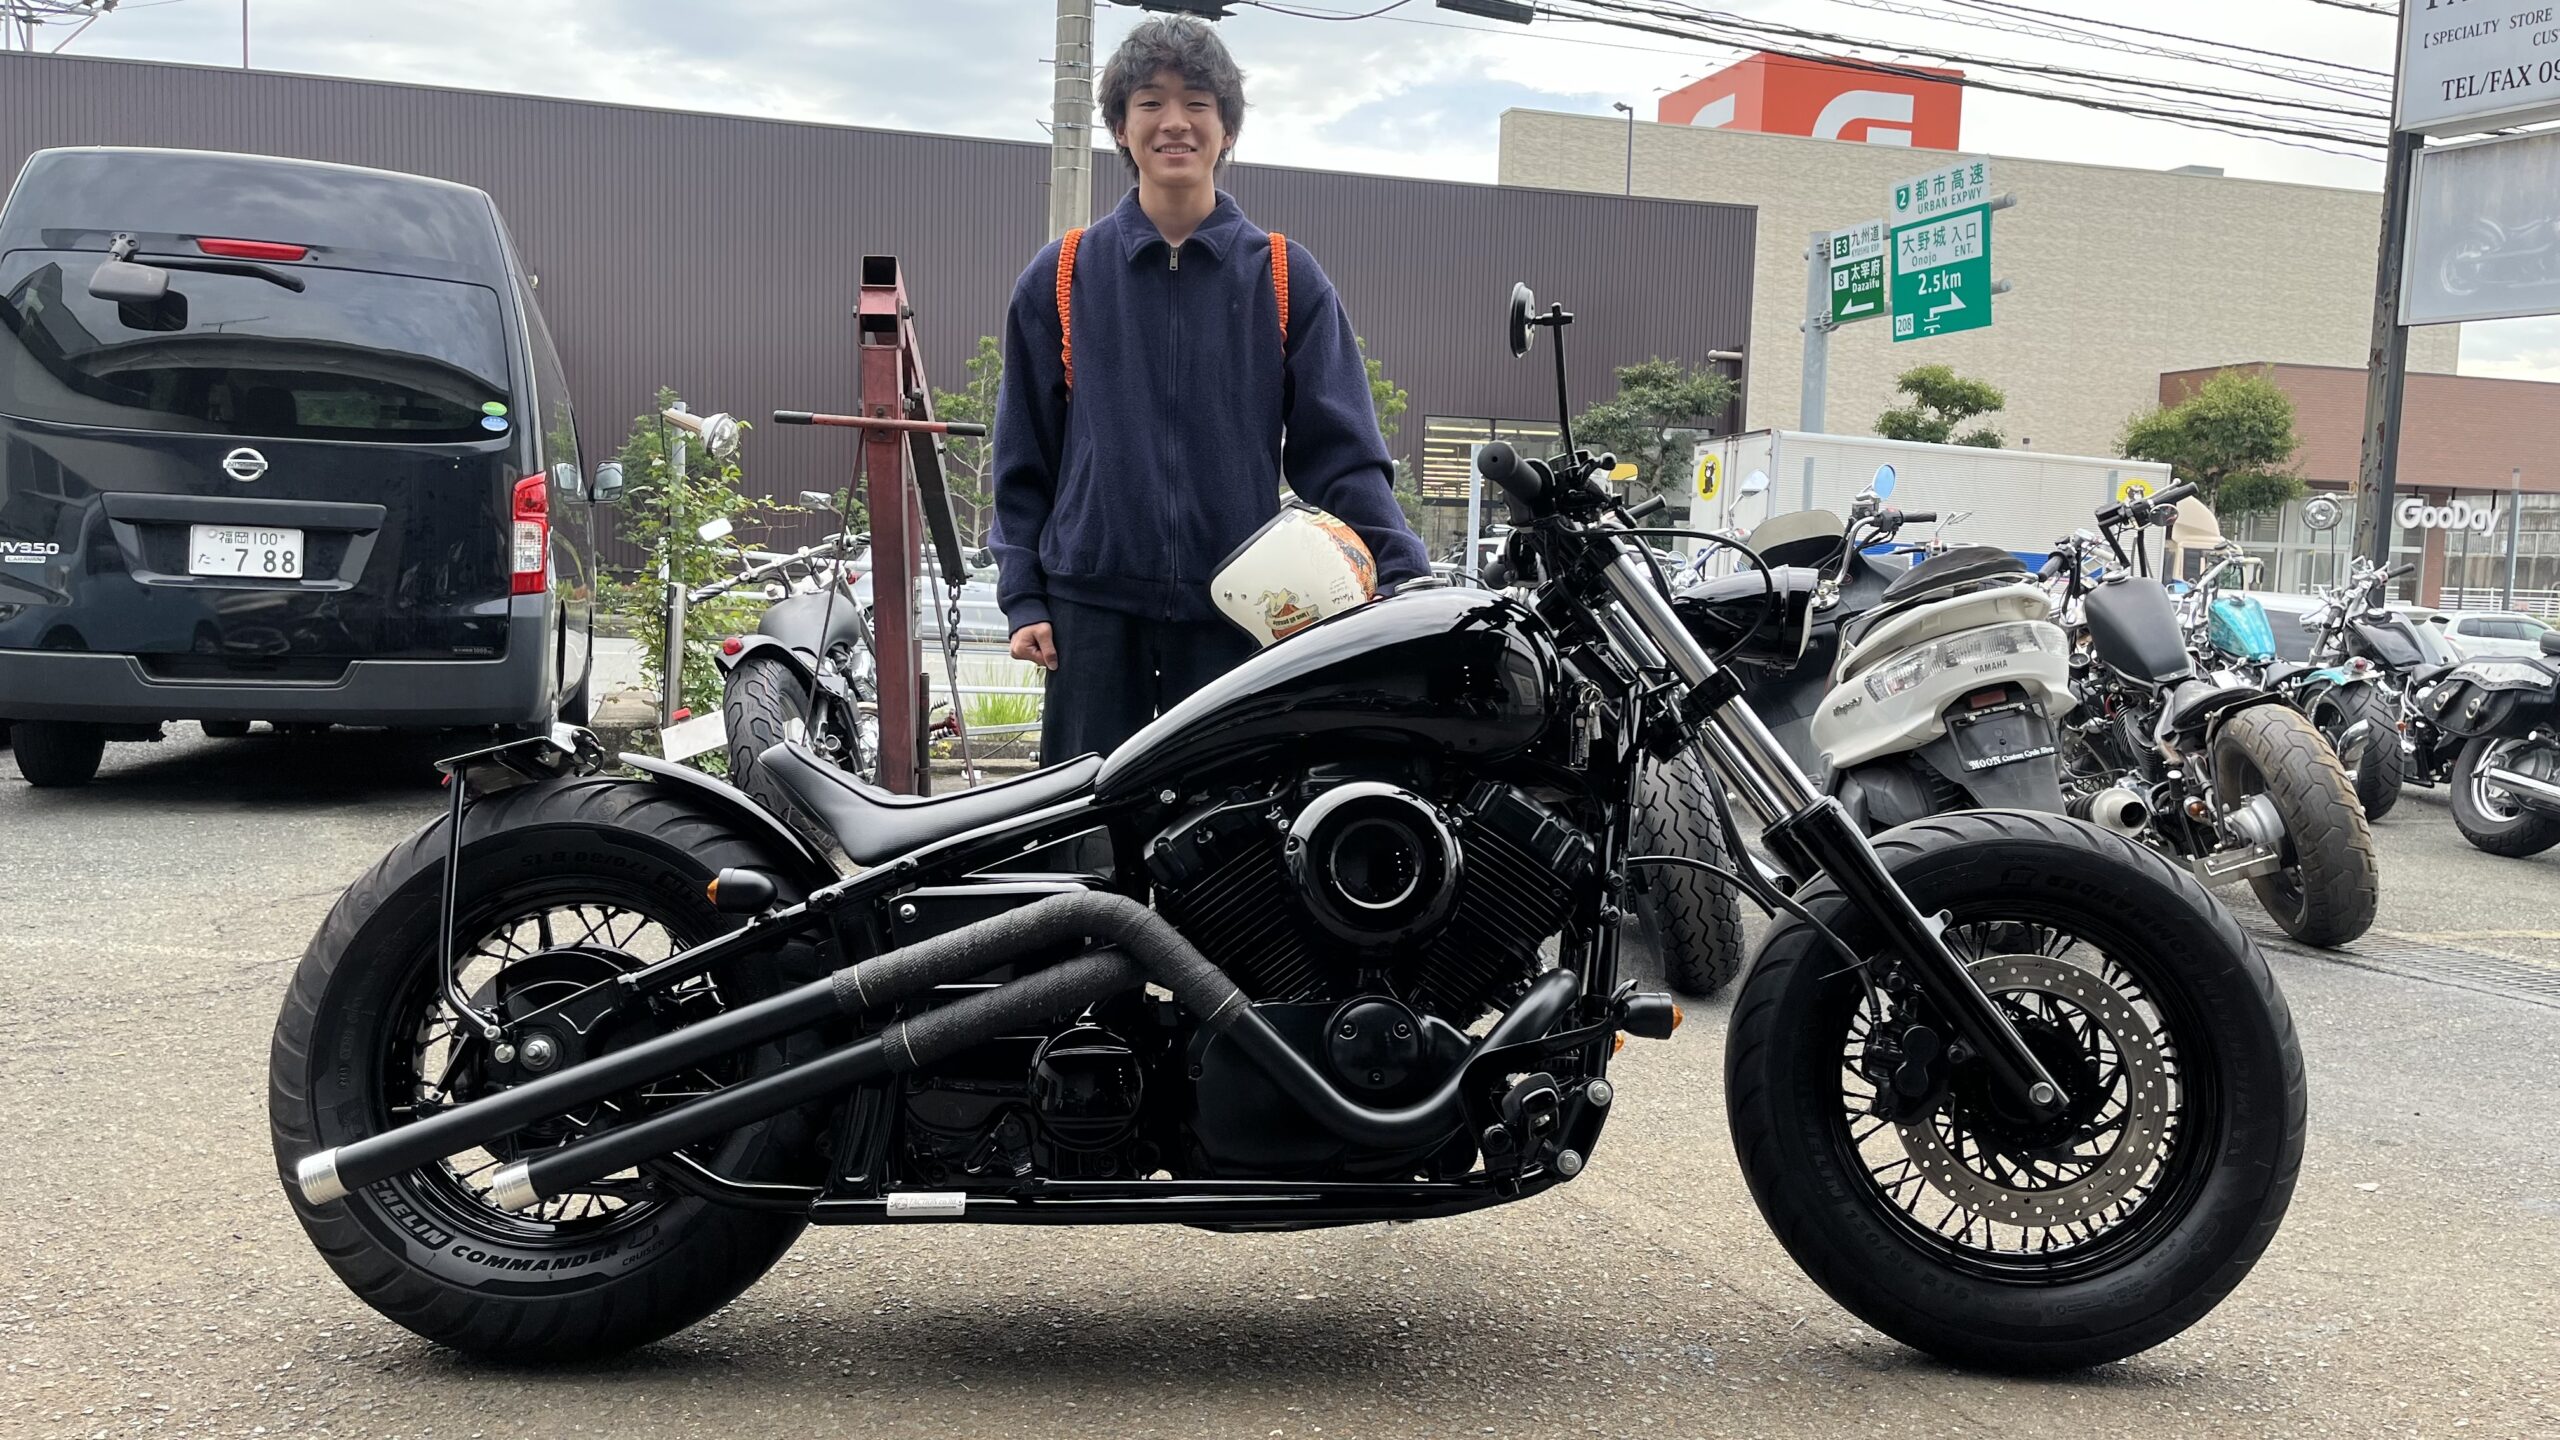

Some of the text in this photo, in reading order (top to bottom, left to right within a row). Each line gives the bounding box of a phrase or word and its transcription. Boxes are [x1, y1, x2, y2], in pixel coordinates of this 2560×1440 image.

[2432, 18, 2500, 46] SPECIALTY
[2509, 7, 2553, 29] STORE
[2533, 28, 2560, 46] CUS
[2442, 63, 2533, 101] TEL/FAX
[1915, 162, 1984, 202] 都市高速
[1899, 189, 1907, 208] 2
[1917, 186, 1982, 215] URBAN EXPWY
[1835, 238, 1848, 256] E3
[1851, 224, 1880, 248] 九州道
[1902, 222, 1977, 256] 大野城 入口
[1911, 243, 1974, 268] Onojo ENT.
[1838, 273, 1845, 288] 8
[1850, 258, 1880, 282] 太宰府
[1852, 277, 1880, 294] Dazaifu
[1897, 317, 1912, 333] 208
[2396, 496, 2502, 537] GooDay
[218, 531, 278, 546] 福岡 100
[198, 552, 211, 565] た
[1973, 659, 2008, 675] YAMAHA
[451, 1244, 620, 1272] COMMANDER
[621, 1239, 665, 1266] CRUISER
